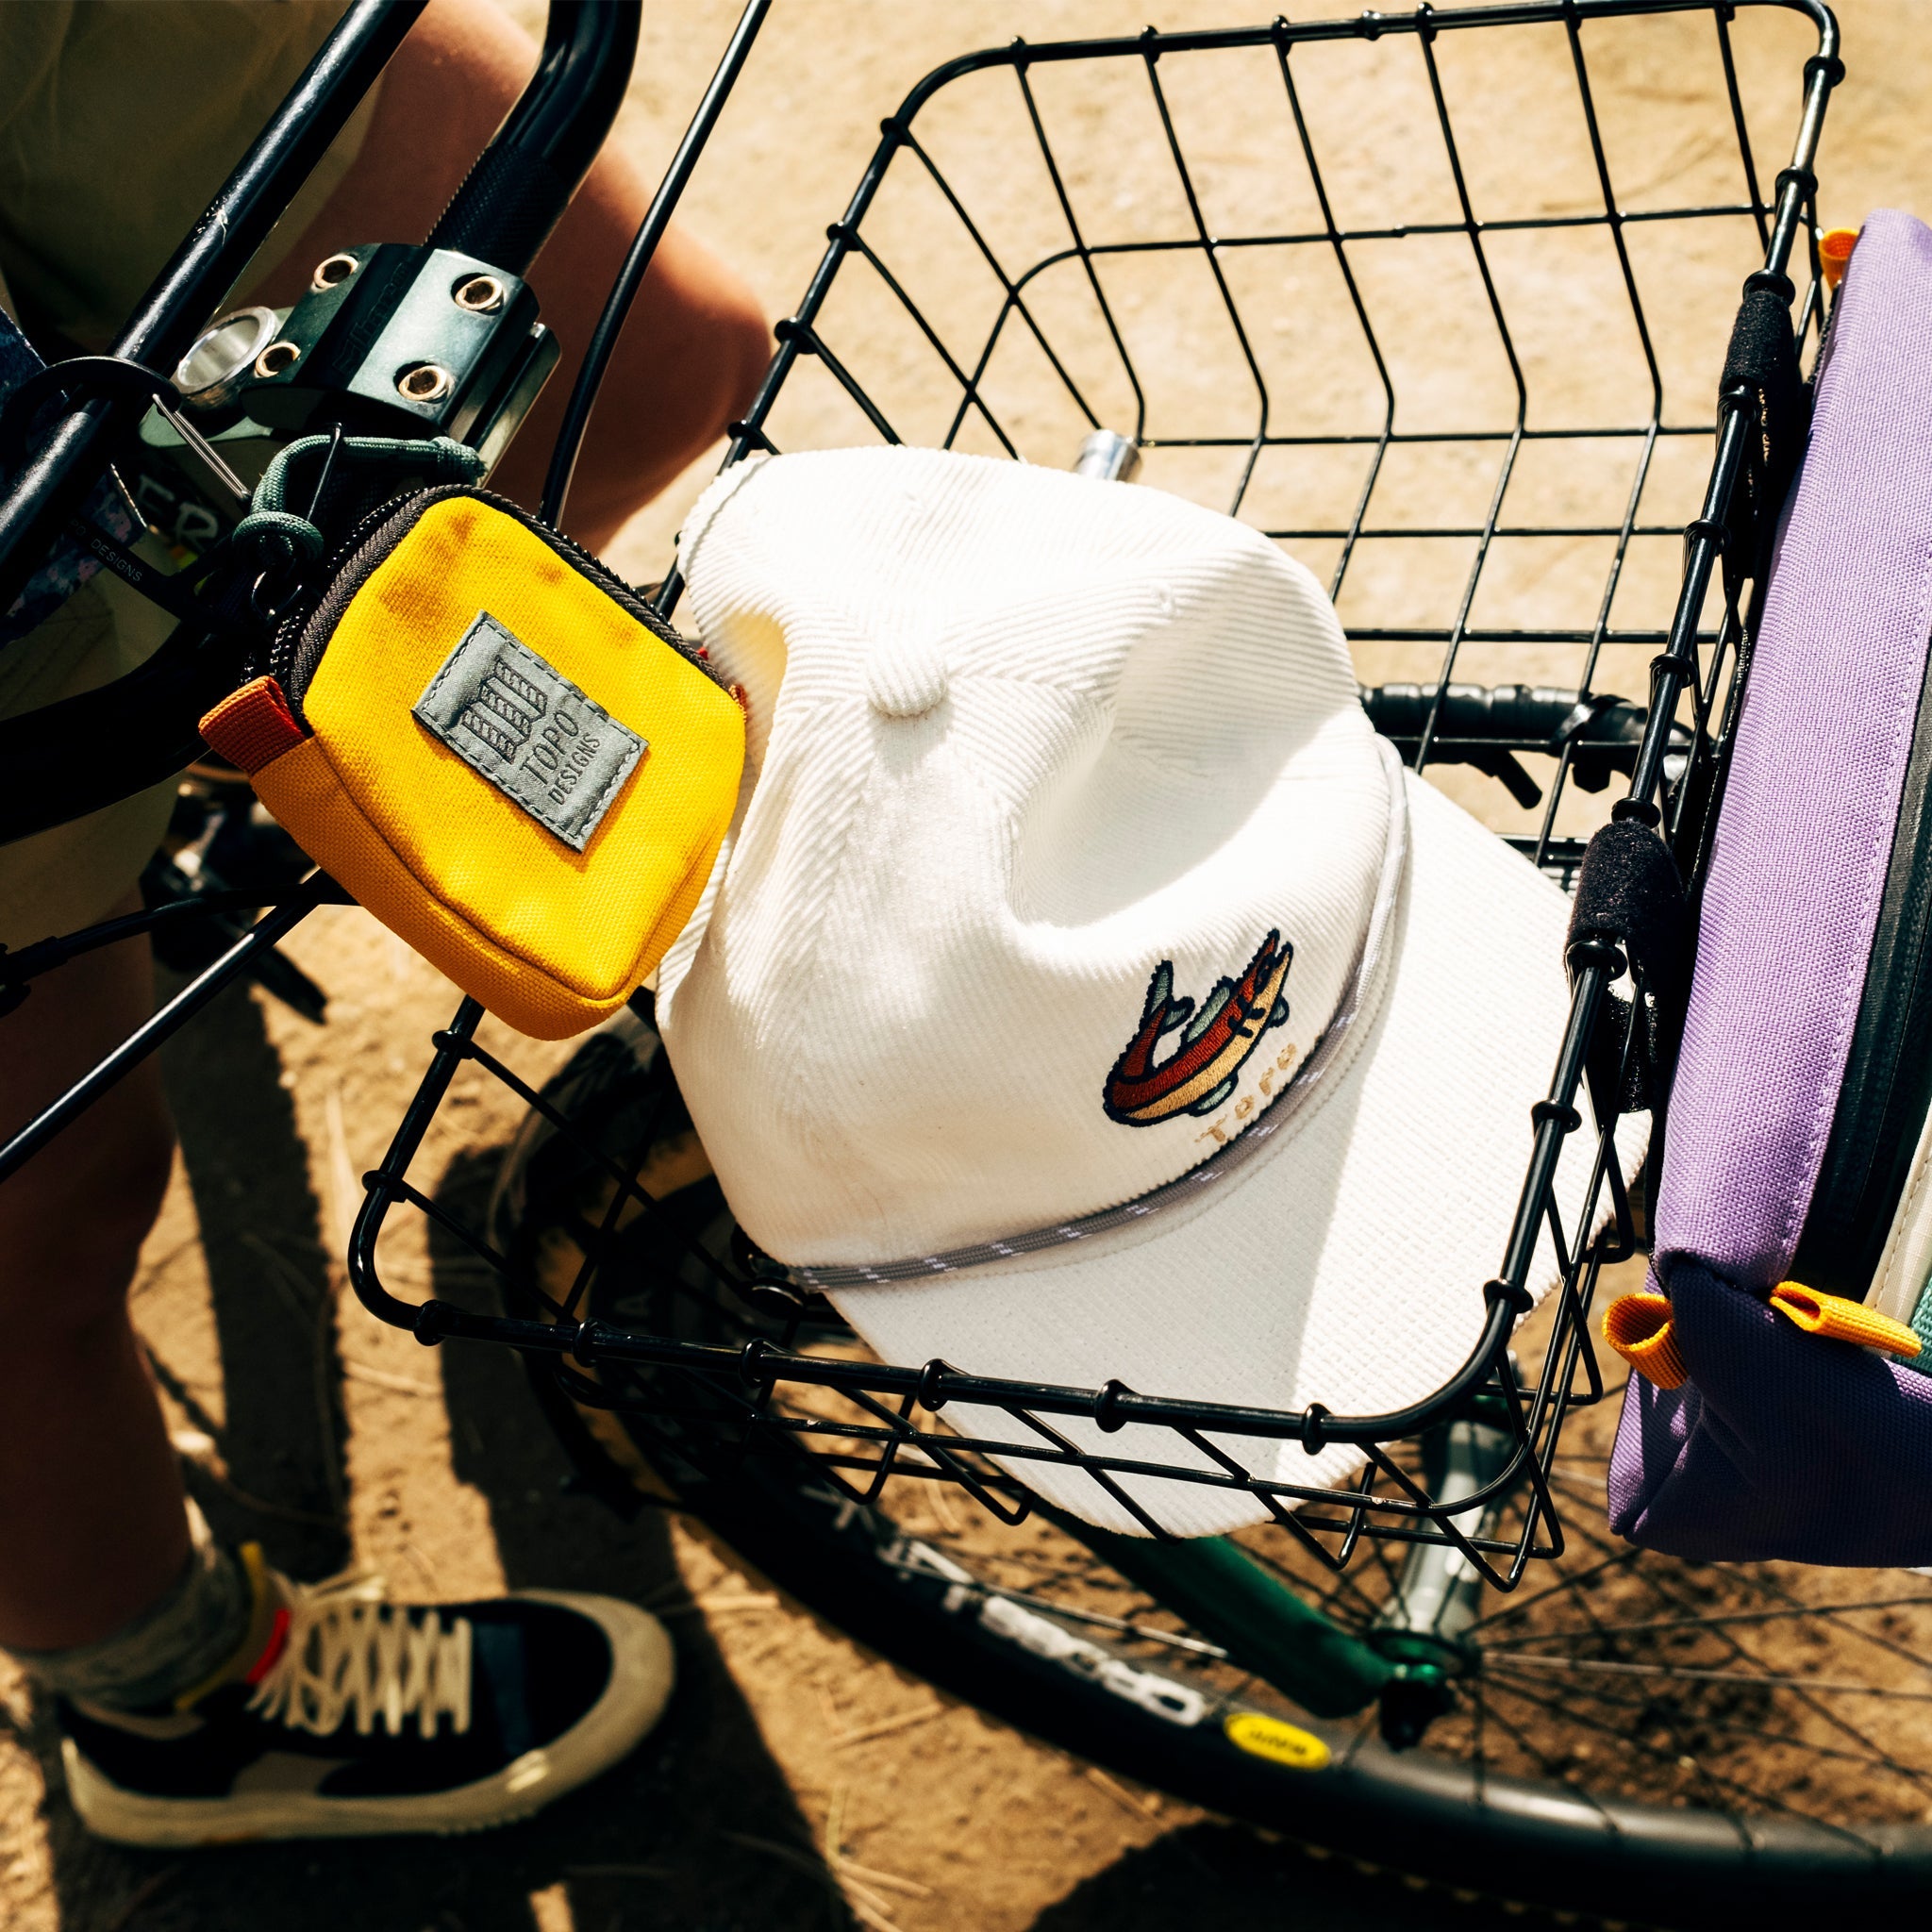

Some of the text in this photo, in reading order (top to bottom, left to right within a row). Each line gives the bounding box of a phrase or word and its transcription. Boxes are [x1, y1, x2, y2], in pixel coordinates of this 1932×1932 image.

[91, 538, 142, 583] DESIGNS
[520, 709, 579, 785] TOPO
[548, 733, 600, 805] DESIGNS
